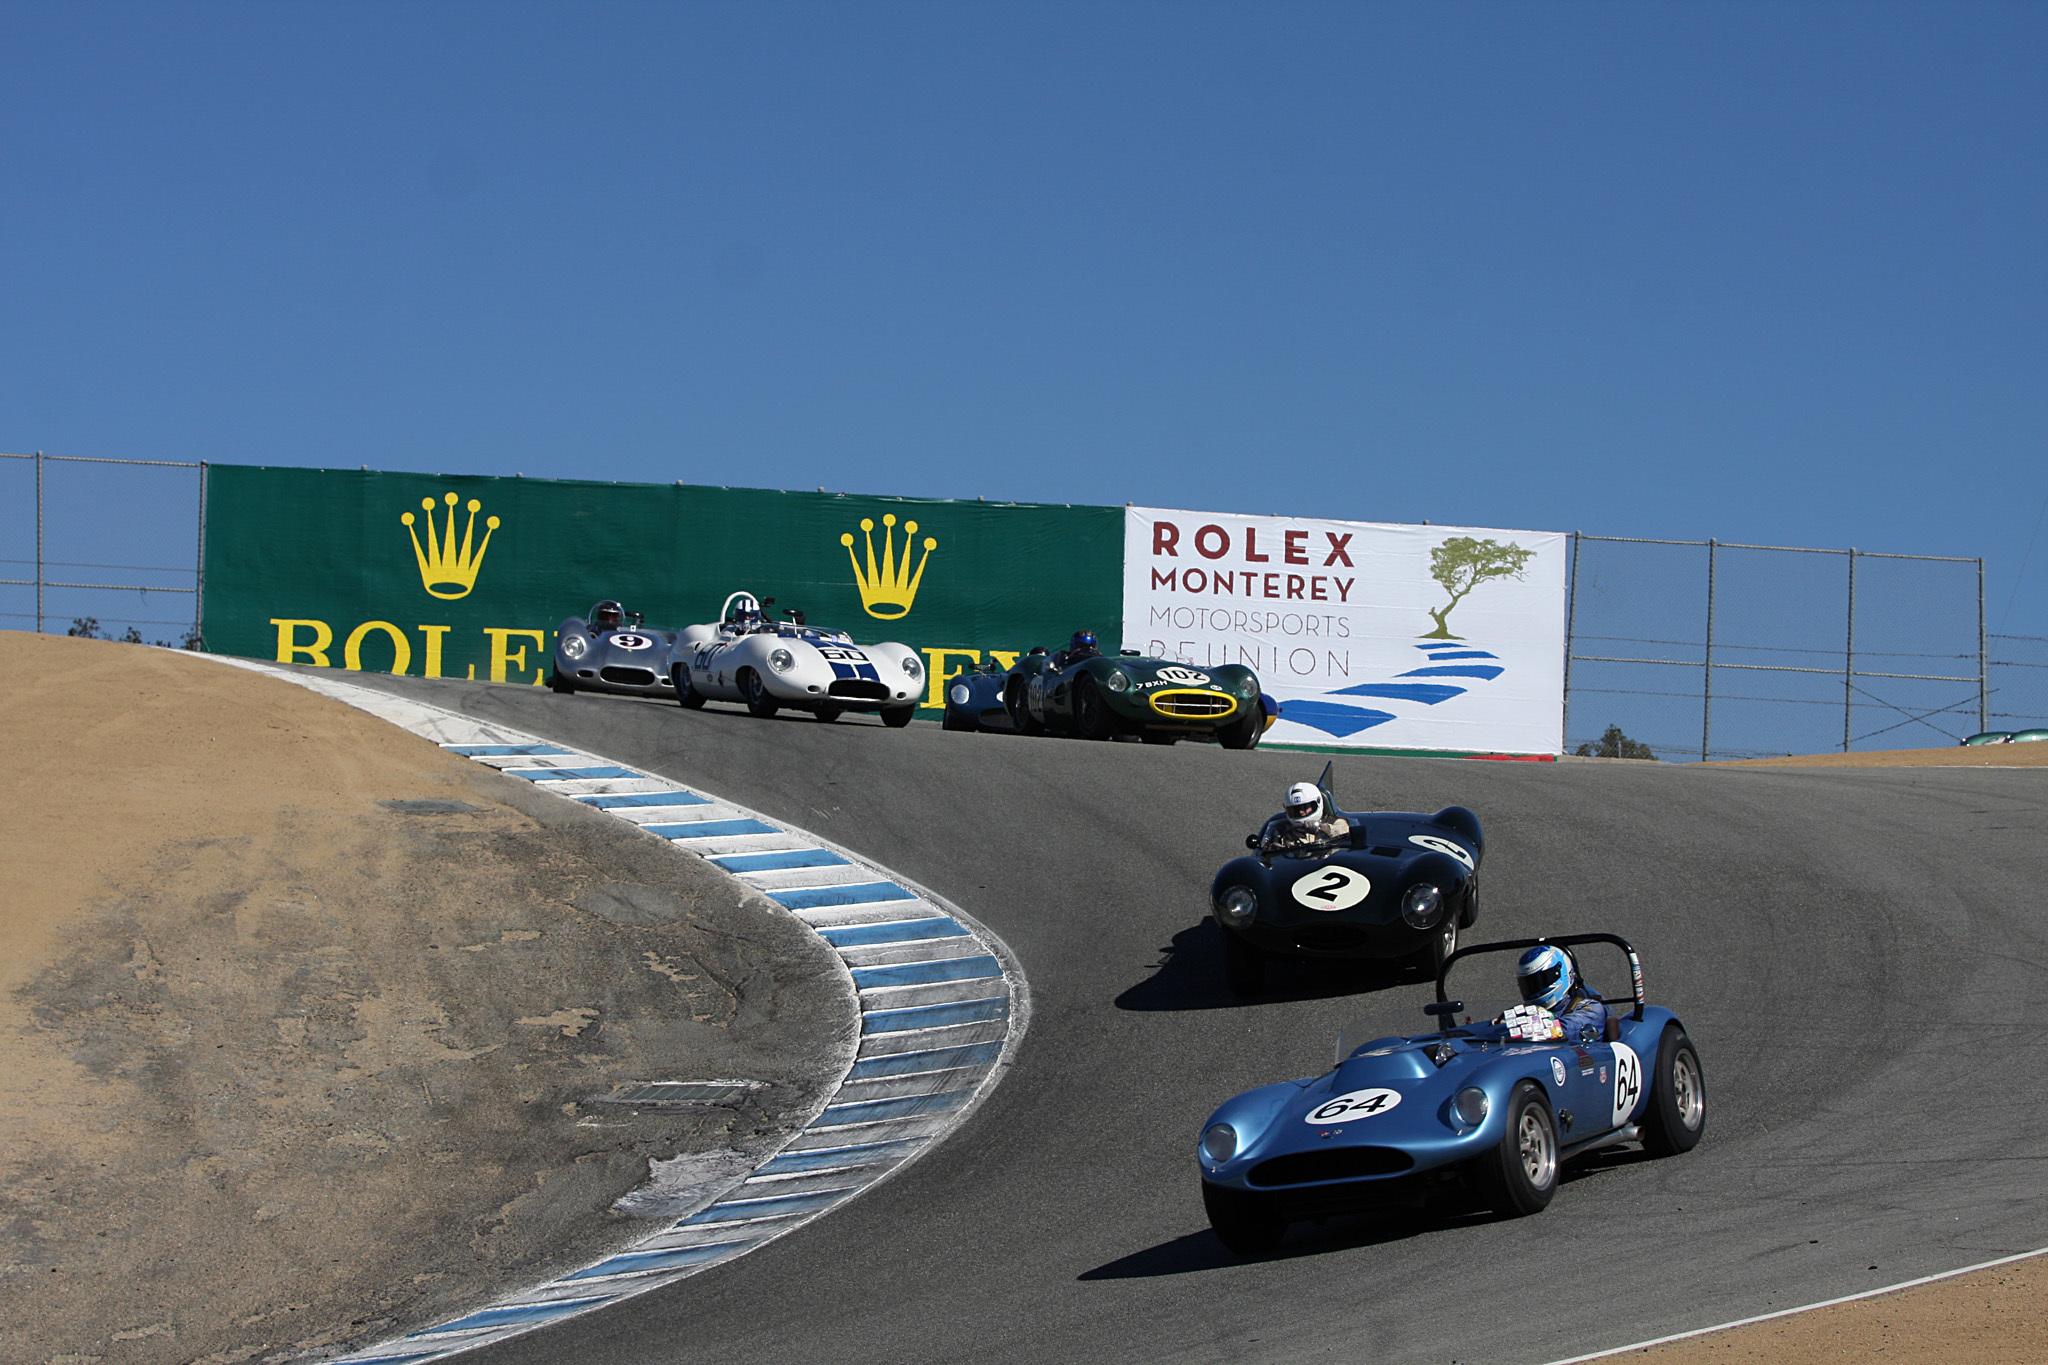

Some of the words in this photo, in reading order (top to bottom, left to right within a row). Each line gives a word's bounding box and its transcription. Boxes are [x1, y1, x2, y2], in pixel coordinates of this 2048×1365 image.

[1152, 521, 1355, 568] ROLEX
[1151, 566, 1355, 602] MONTEREY
[1150, 606, 1350, 638] MOTORSPORTS
[270, 618, 558, 687] ROLE
[618, 635, 644, 647] 9
[818, 649, 870, 662] 60
[1161, 670, 1207, 681] 102
[1423, 839, 1468, 860] 2
[1305, 872, 1351, 902] 2
[1617, 1055, 1638, 1111] 64
[1314, 1094, 1389, 1119] 64
